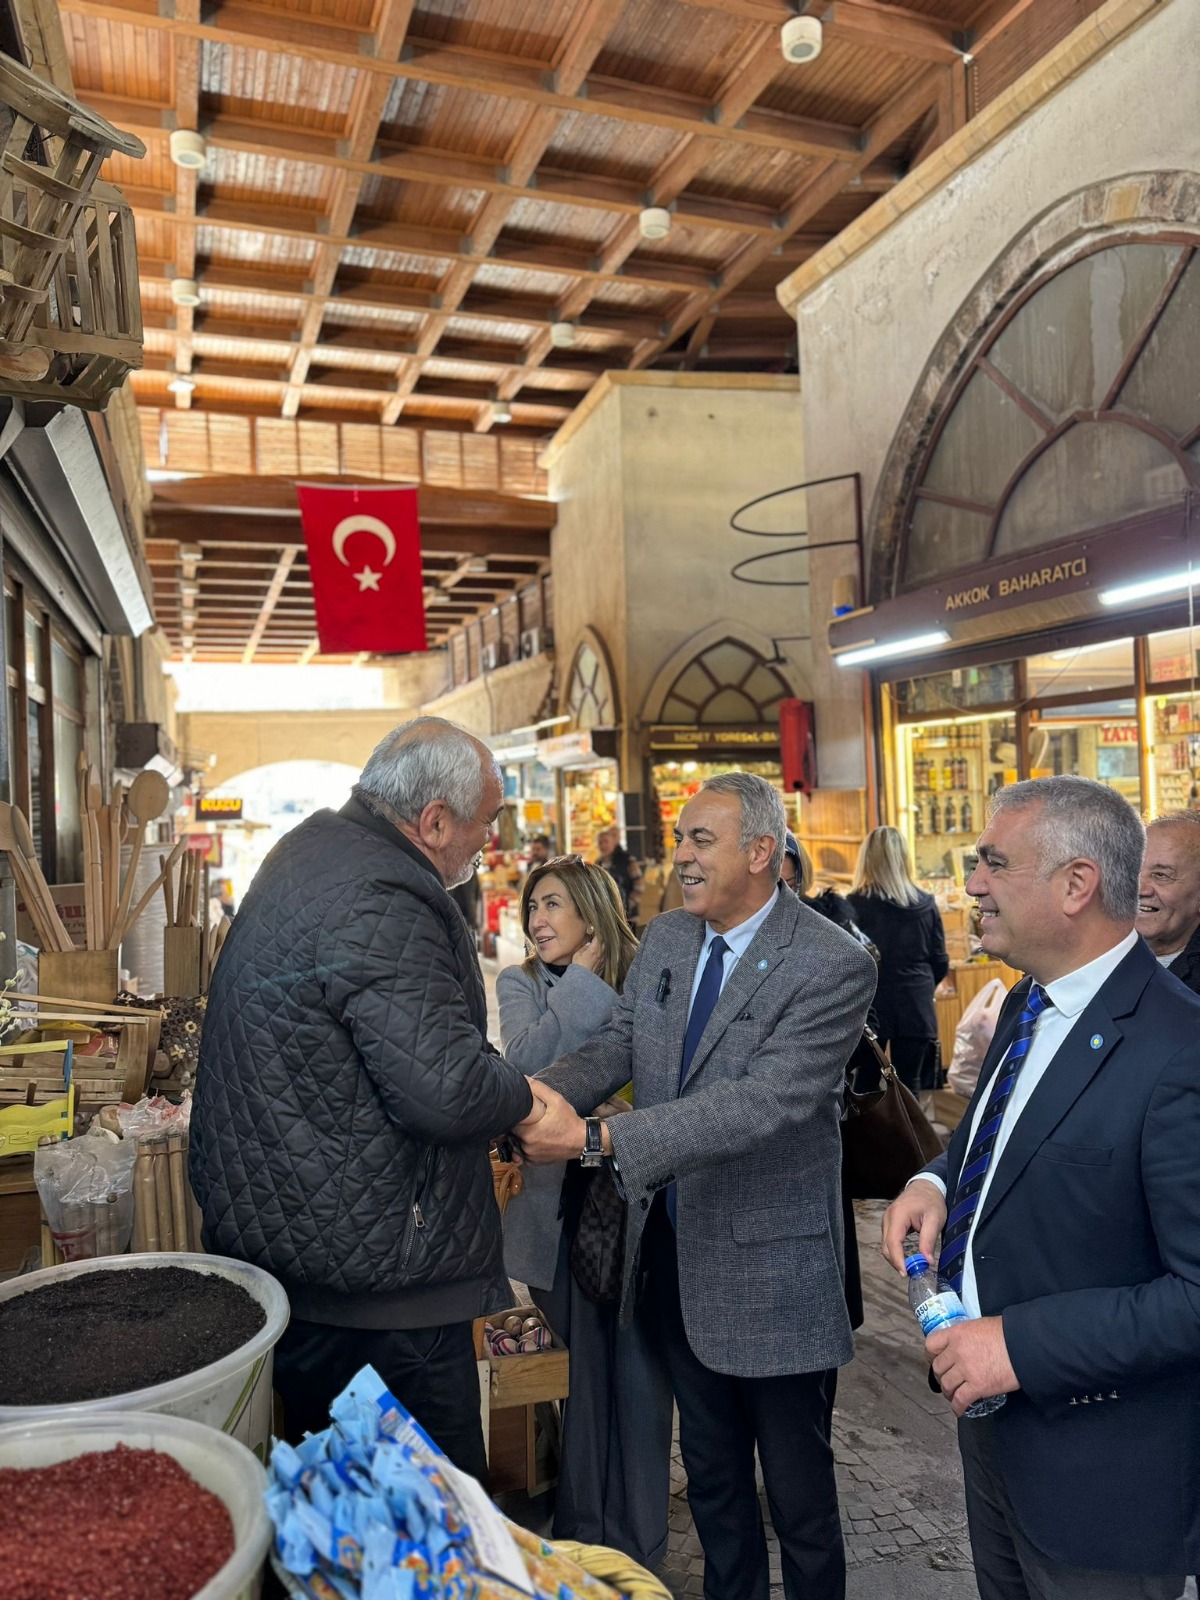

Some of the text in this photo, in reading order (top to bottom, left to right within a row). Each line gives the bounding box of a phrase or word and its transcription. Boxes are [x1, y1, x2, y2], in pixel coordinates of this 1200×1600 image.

[945, 557, 1087, 611] AKKOK BAHARATCI
[200, 798, 242, 811] KUZU
